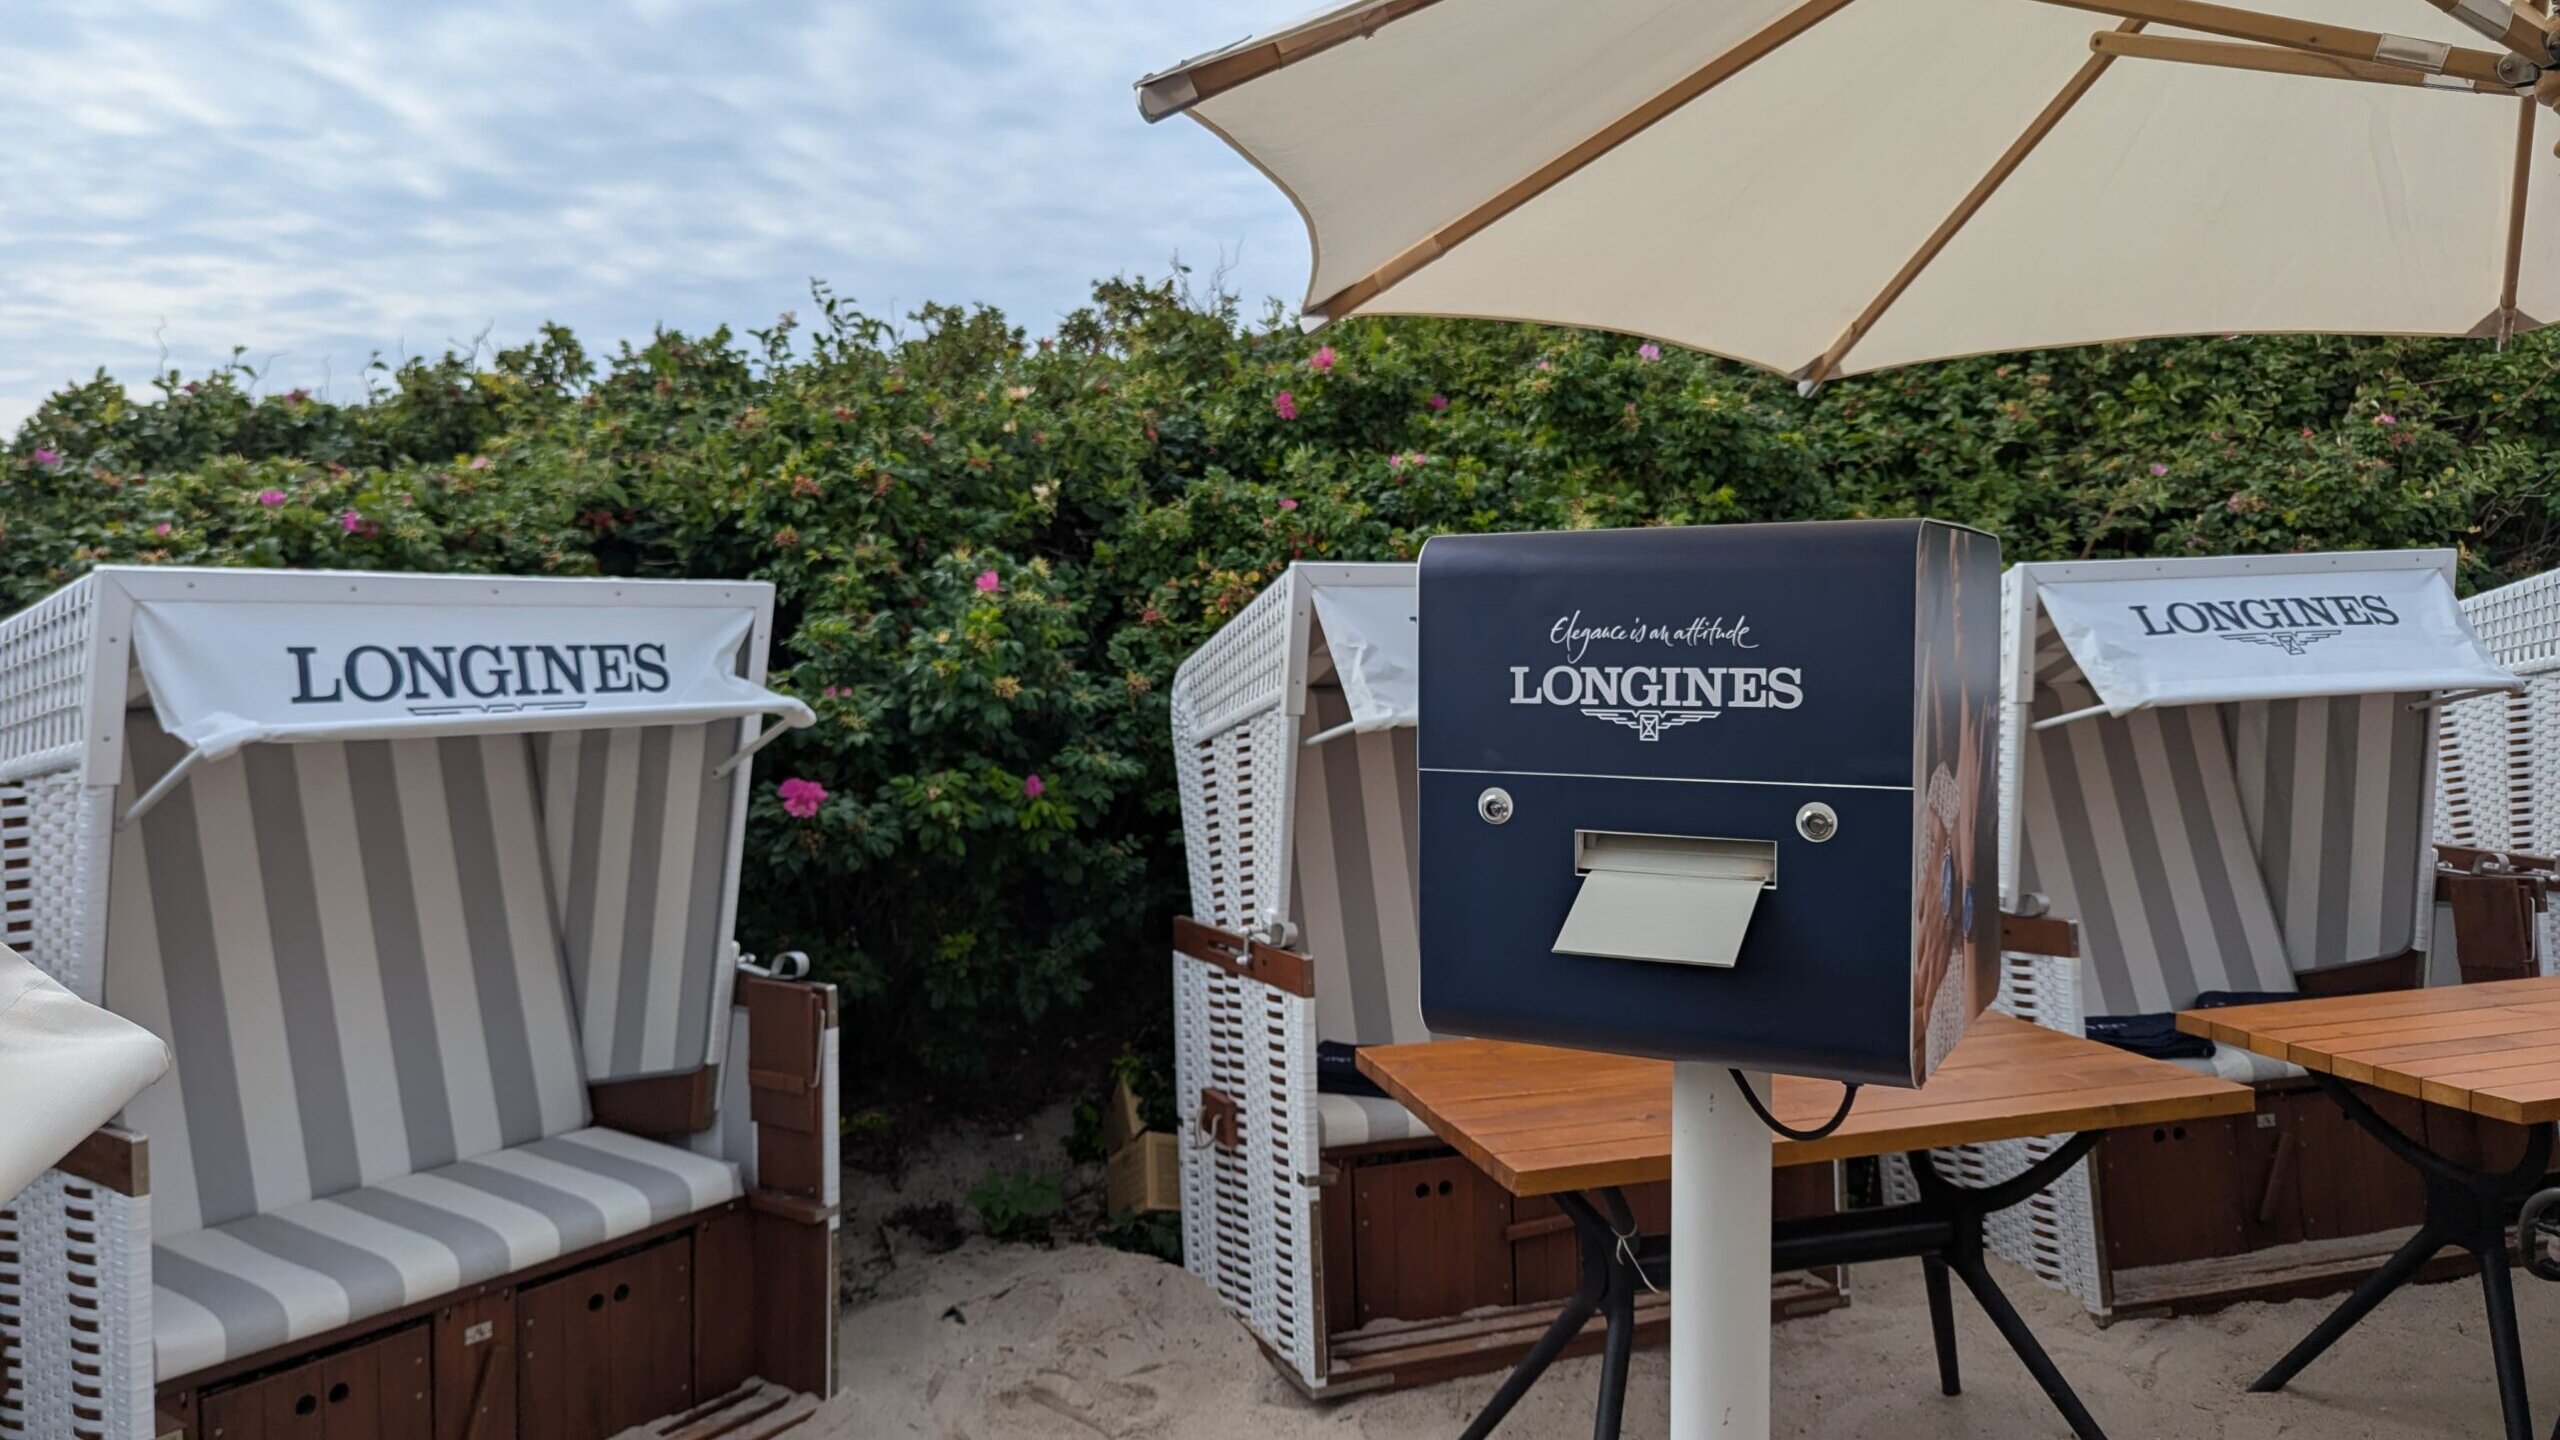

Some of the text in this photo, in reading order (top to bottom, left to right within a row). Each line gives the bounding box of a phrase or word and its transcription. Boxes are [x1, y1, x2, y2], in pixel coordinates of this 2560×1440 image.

[1550, 610, 1760, 664] Elegance is an attitude
[2129, 595, 2399, 636] LONGINES
[286, 643, 671, 704] LONGINES
[1509, 665, 1804, 710] LONGINES
